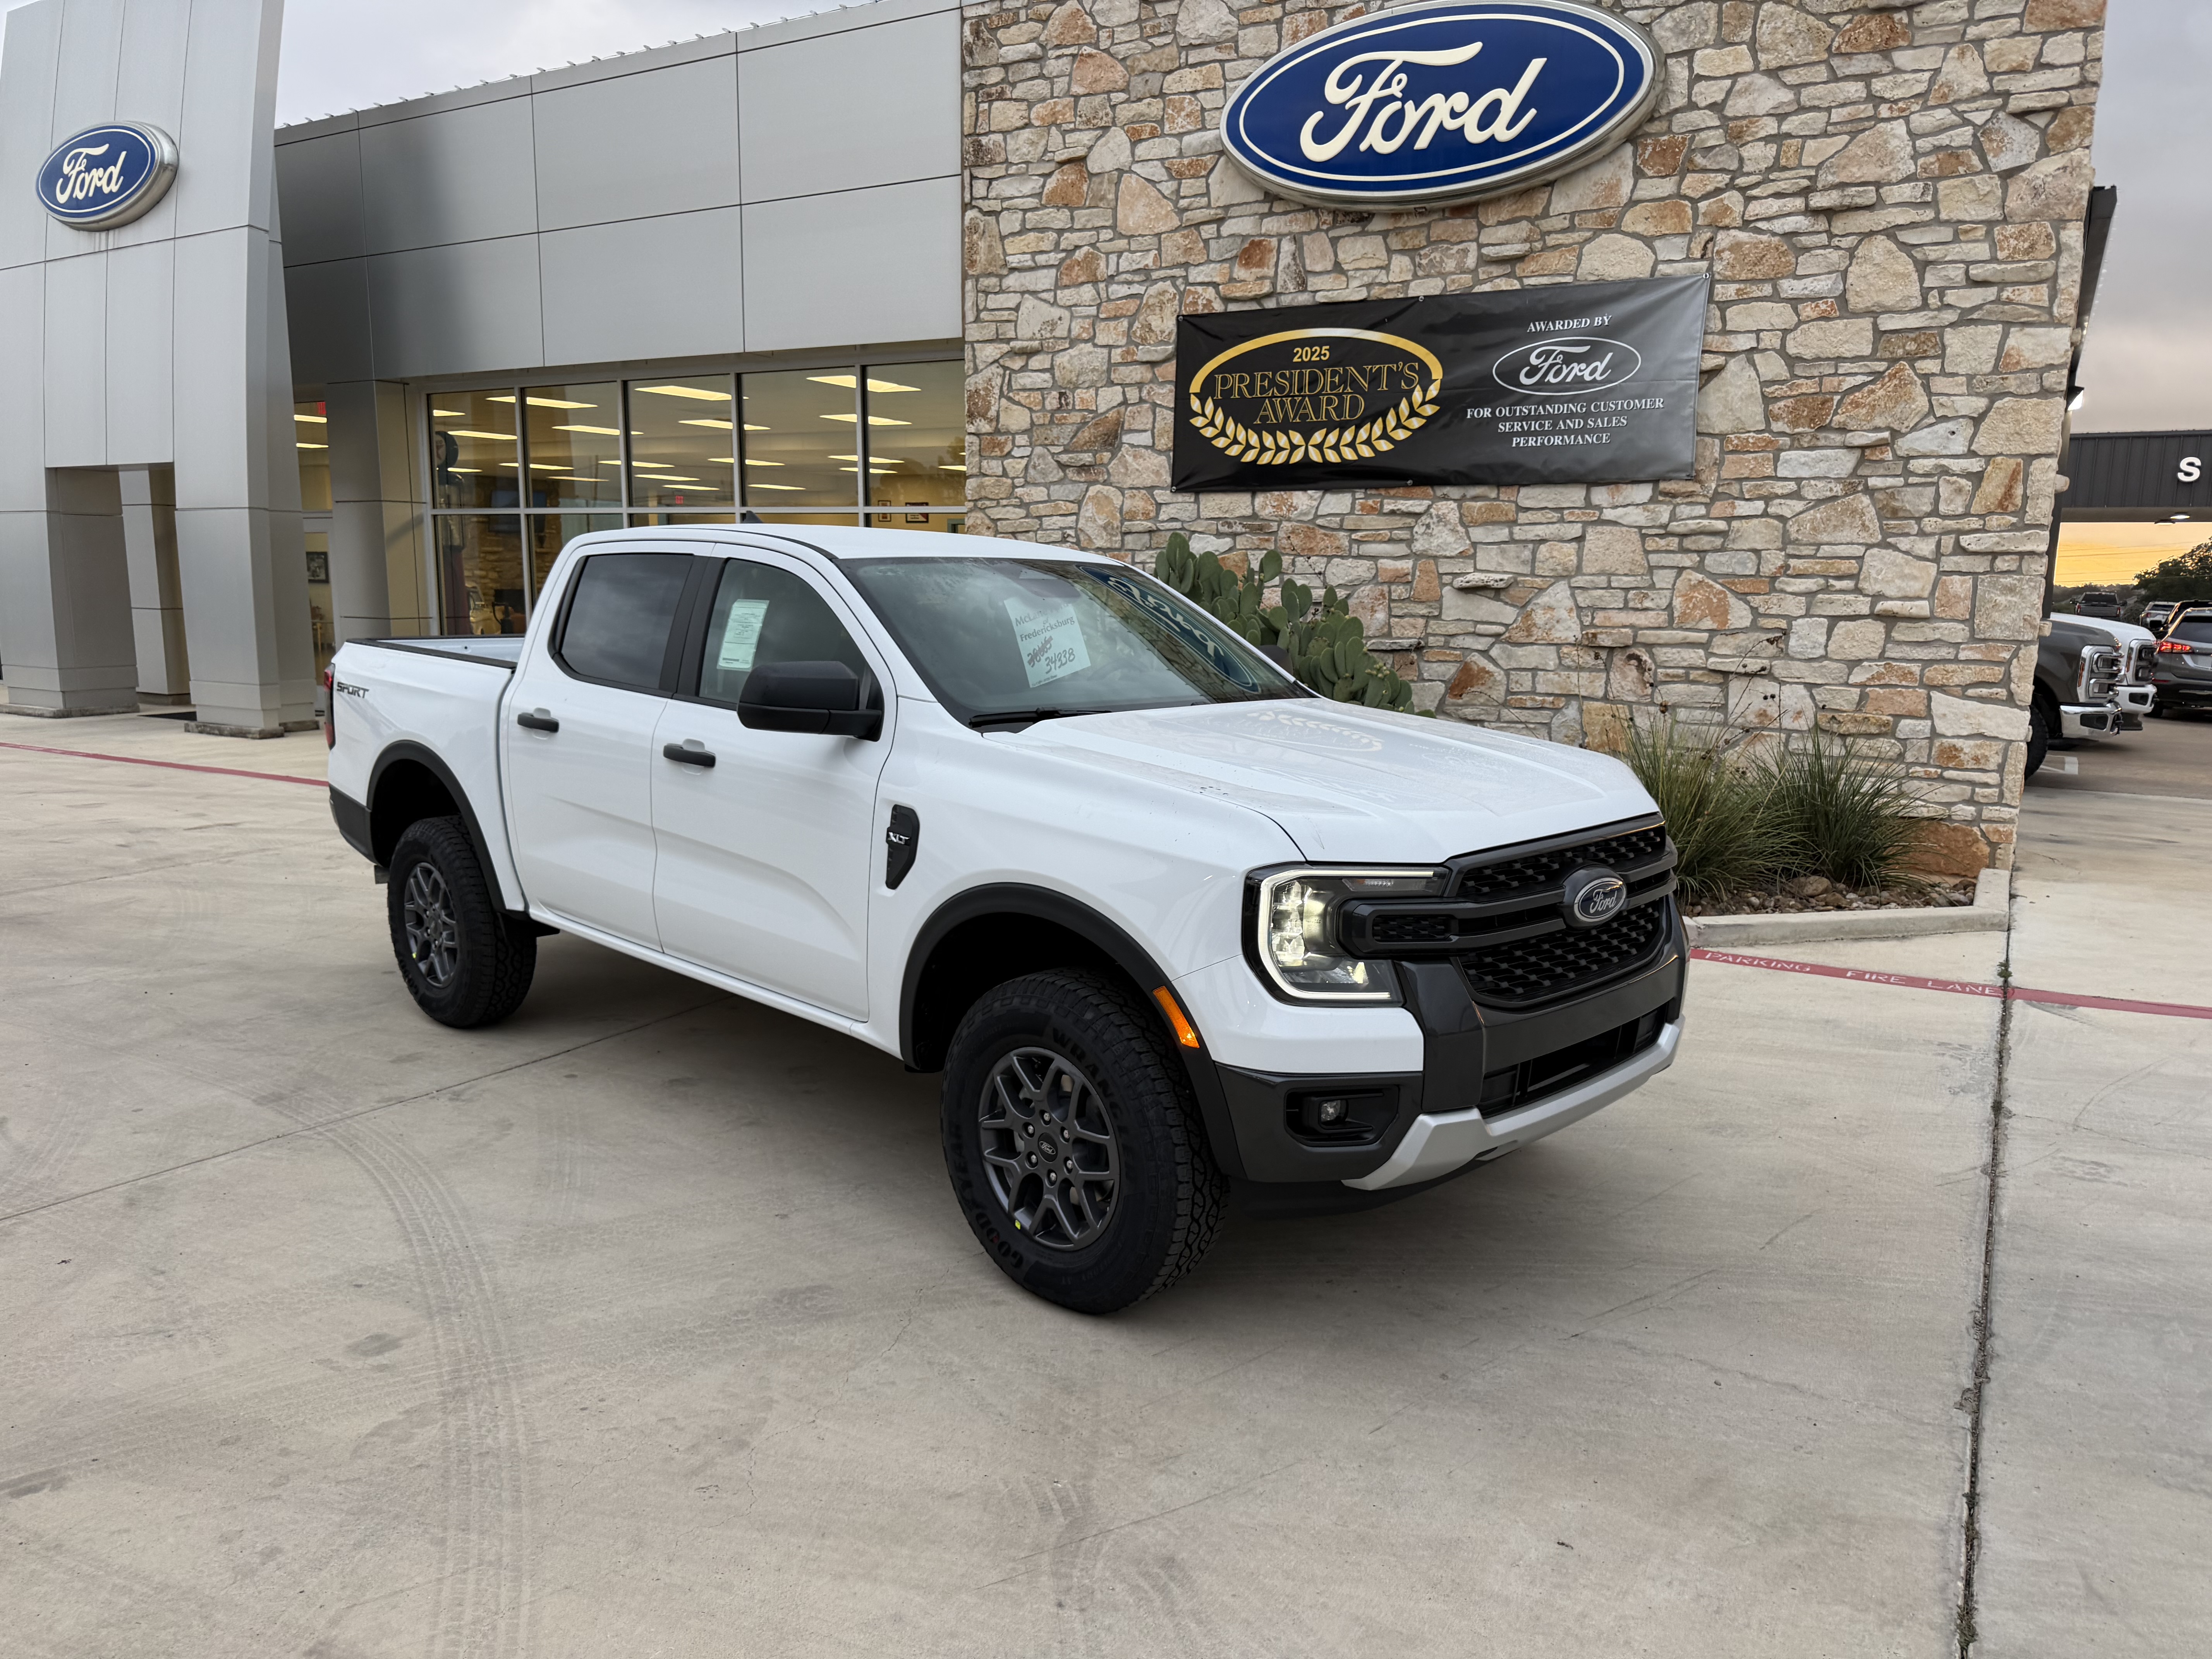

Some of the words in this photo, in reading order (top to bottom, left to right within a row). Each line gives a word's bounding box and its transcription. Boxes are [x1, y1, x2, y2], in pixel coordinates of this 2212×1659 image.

[1300, 41, 1547, 162] Ford
[56, 144, 127, 204] Ford
[1527, 318, 1590, 333] AWARDED
[1594, 315, 1612, 326] BY
[1292, 346, 1330, 362] 2025
[1519, 345, 1613, 385] Ford
[1213, 362, 1419, 400] PRESIDENT'S
[1253, 394, 1365, 424] AWARD
[1467, 408, 1492, 419] FOR
[1496, 403, 1587, 418] OUTSTANDING
[1591, 398, 1664, 413] CUSTOMER
[1498, 419, 1553, 433] SERVICE
[1556, 418, 1584, 430] AND
[1587, 416, 1628, 429] SALES
[1512, 433, 1611, 447] PERFORMANCE
[2178, 457, 2201, 483] S
[1020, 617, 1075, 642] Fredericksburg
[337, 682, 370, 699] SPORT
[1590, 885, 1620, 914] Ford
[1705, 952, 1810, 972] PARKING
[1846, 970, 1906, 985] FIRE
[1927, 980, 2002, 996] LANE
